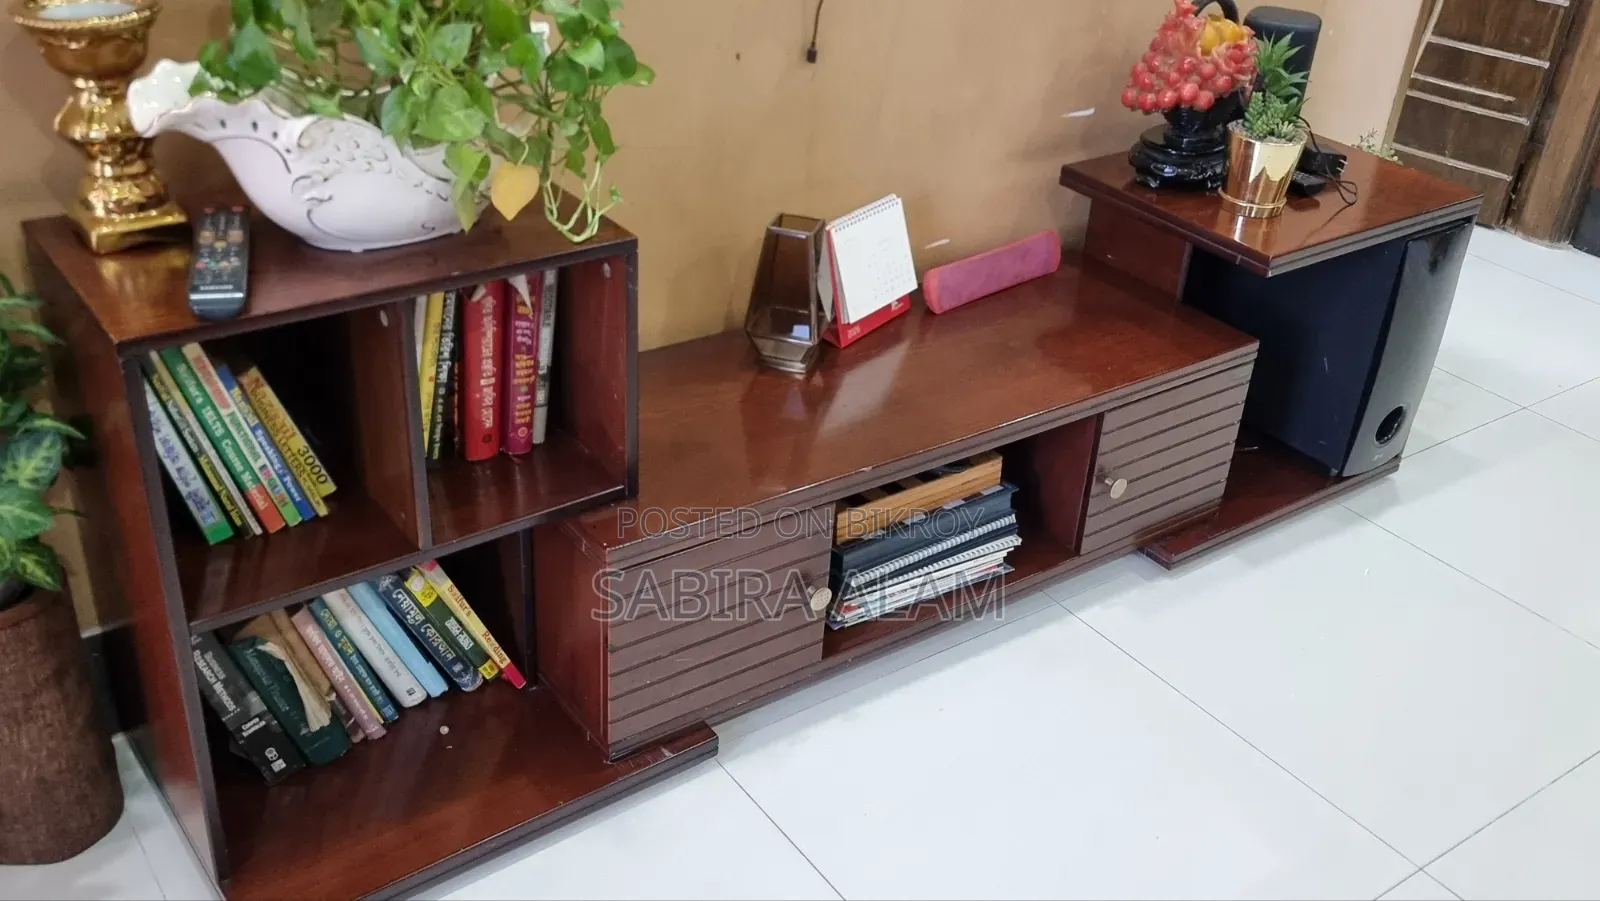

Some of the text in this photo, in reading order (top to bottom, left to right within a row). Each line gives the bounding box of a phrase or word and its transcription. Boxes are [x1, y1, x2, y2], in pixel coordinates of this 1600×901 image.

[199, 404, 227, 437] IELTS
[217, 437, 247, 474] Course
[238, 470, 270, 511] Material
[275, 435, 308, 477] LETTERS
[295, 444, 329, 487] 3000
[389, 585, 426, 628] নেয়ামুল
[418, 619, 456, 664] কোরআন
[446, 582, 474, 617] Saifur's
[479, 629, 508, 665] Reading
[211, 680, 237, 713] METHODS
